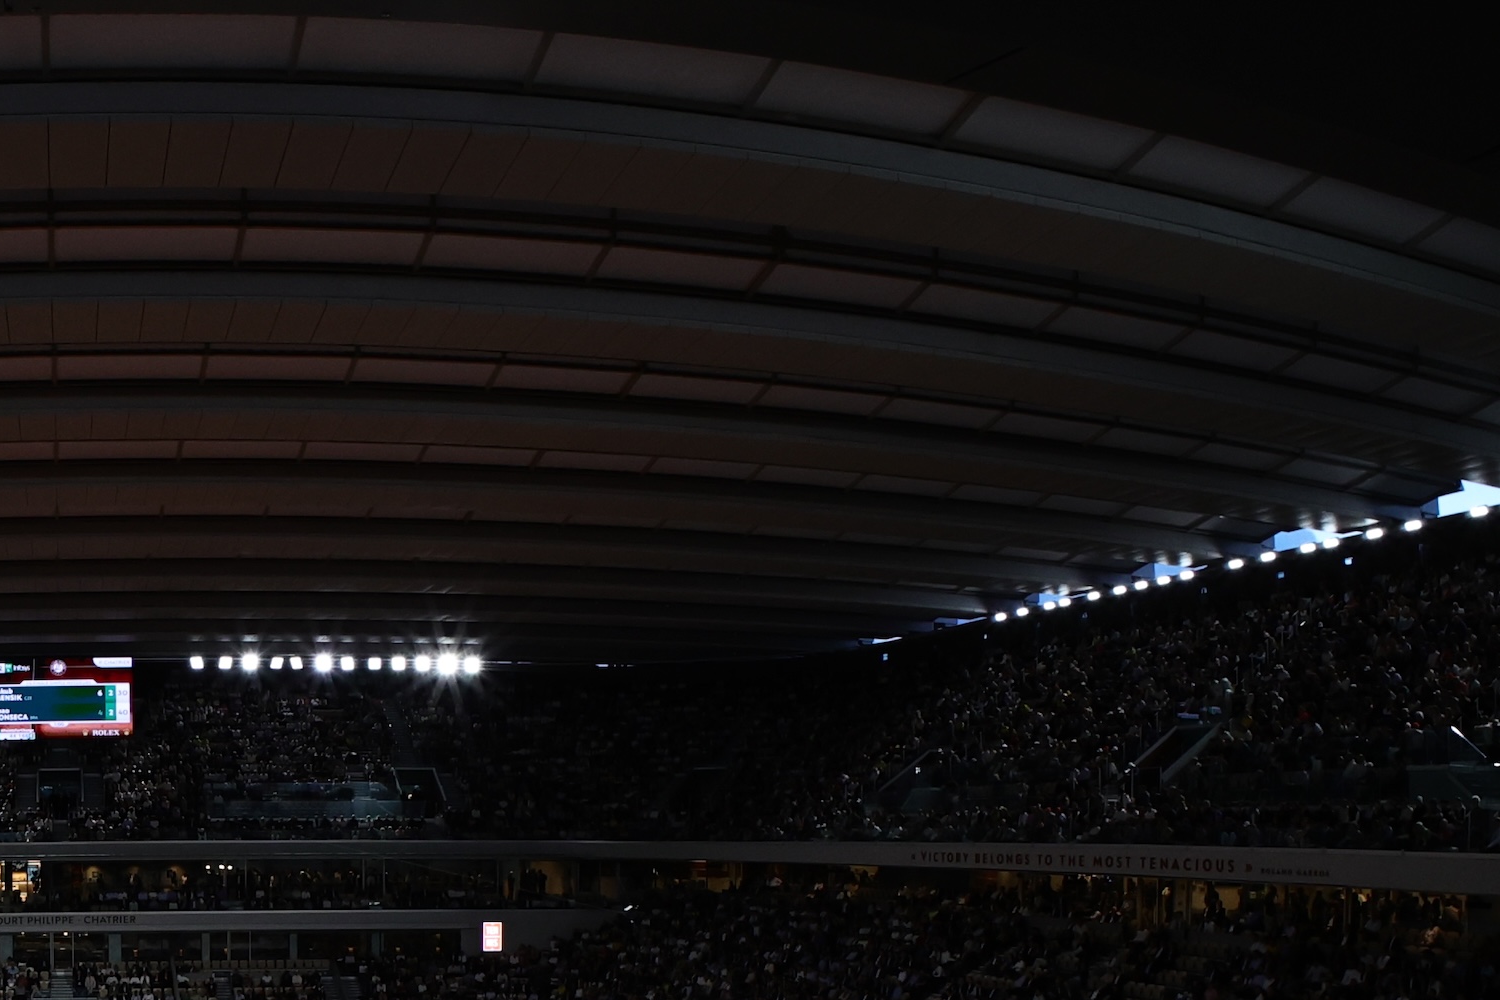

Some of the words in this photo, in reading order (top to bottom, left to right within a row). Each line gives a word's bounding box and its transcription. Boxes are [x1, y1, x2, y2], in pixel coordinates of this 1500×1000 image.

[108, 689, 114, 697] 2
[921, 851, 969, 863] VICTORY
[975, 853, 1030, 865] BELONGS
[1037, 854, 1053, 866] TO
[1060, 855, 1085, 867] THE
[1093, 855, 1131, 869] MOST
[1140, 856, 1235, 873] TENACIOUS
[27, 915, 74, 925] PHILIPPE
[83, 915, 136, 924] CHATRIER
